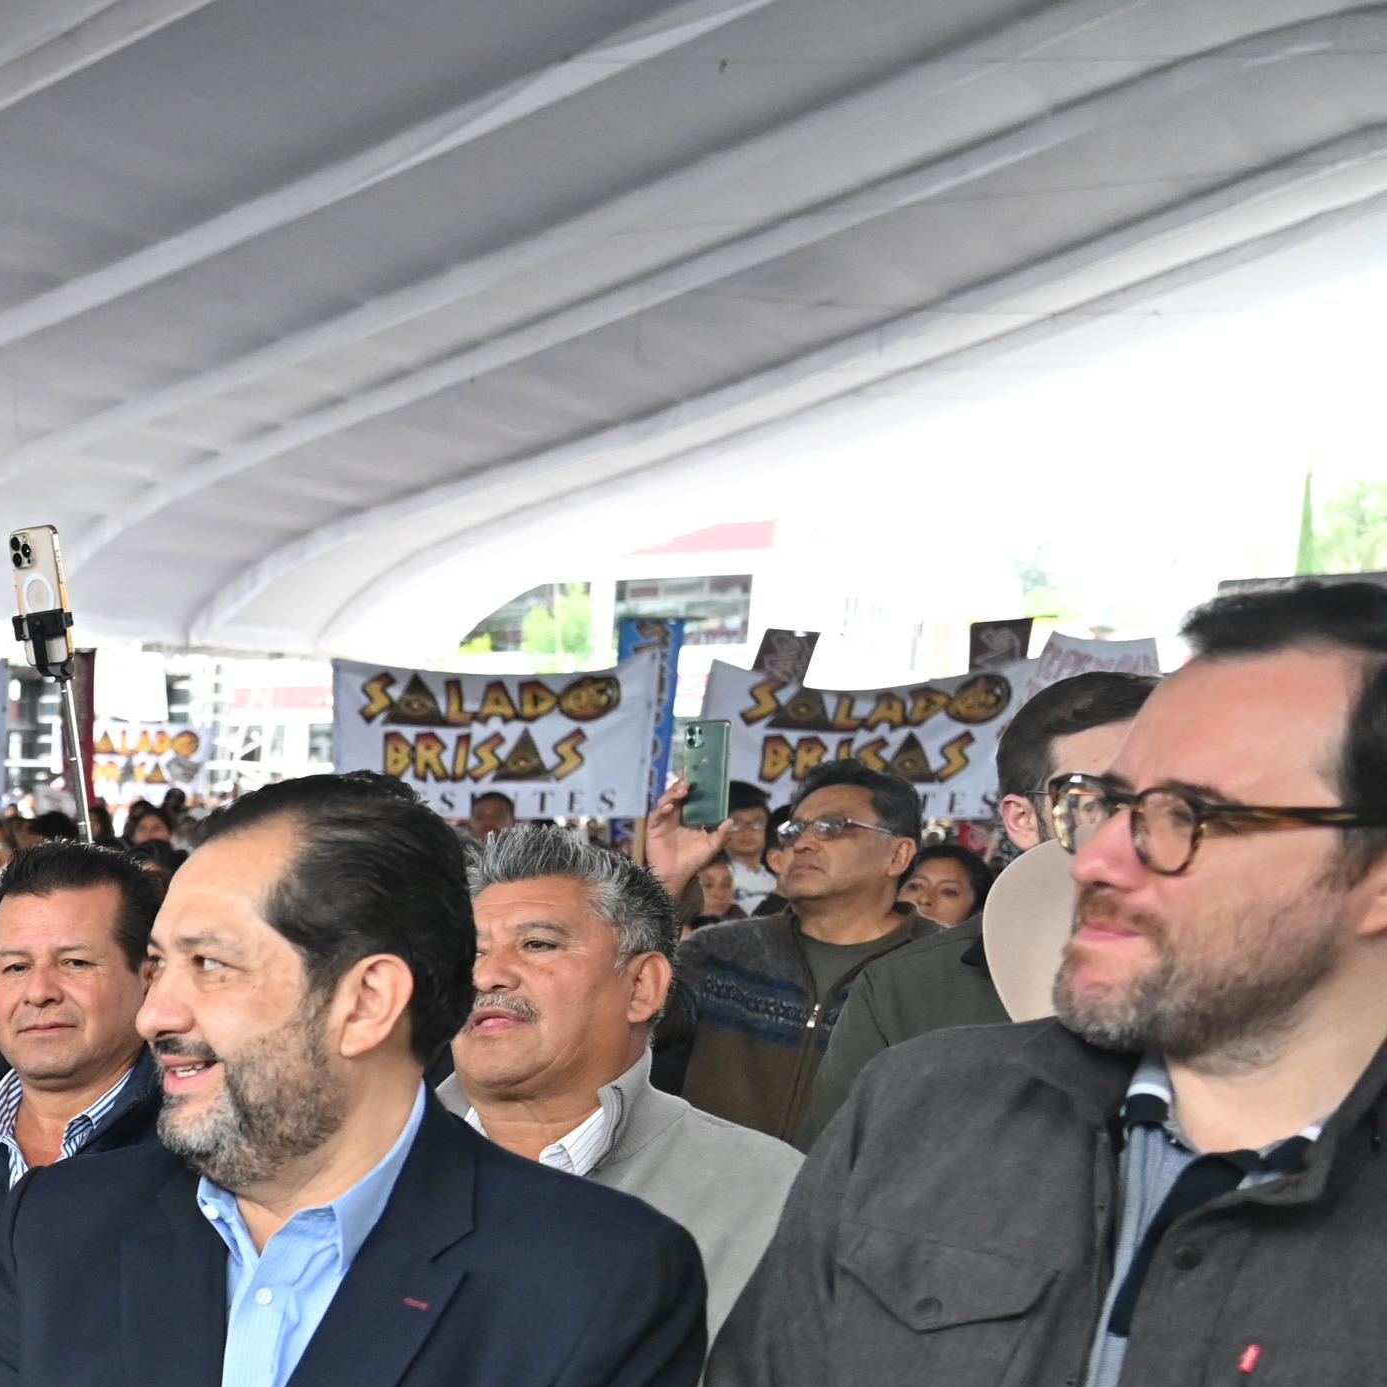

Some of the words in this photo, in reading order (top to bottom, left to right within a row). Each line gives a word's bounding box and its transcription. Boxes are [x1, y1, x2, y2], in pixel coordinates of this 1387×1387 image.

[359, 671, 621, 727] SALADO
[739, 673, 1012, 732] SALADO
[93, 729, 200, 757] ALADO
[384, 727, 587, 783] BRISAS
